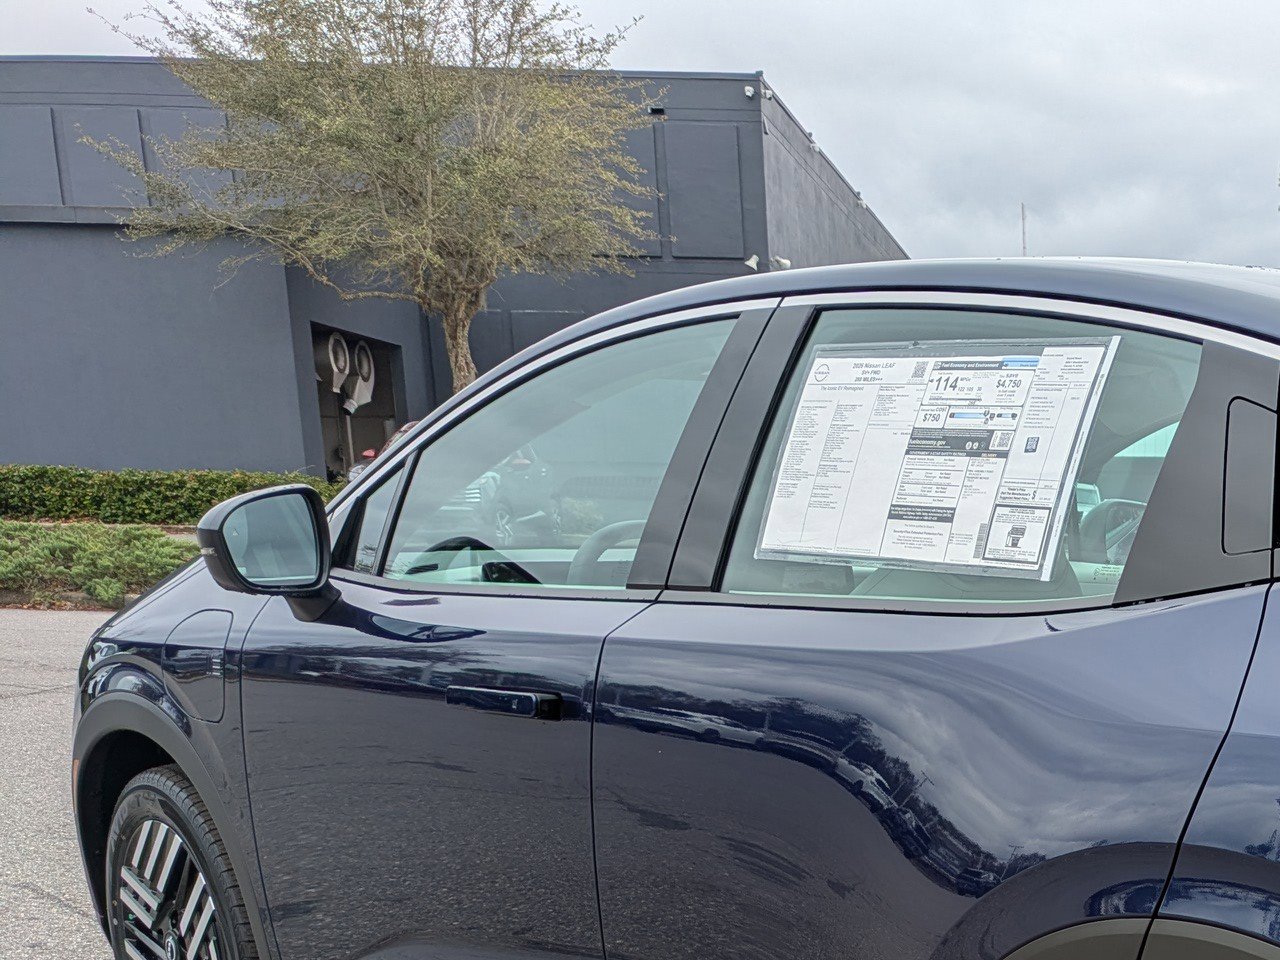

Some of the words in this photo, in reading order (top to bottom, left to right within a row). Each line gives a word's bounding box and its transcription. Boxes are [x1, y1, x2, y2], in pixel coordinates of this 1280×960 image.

[935, 376, 959, 391] 114
[996, 380, 1021, 388] $4,750
[923, 413, 941, 422] $750
